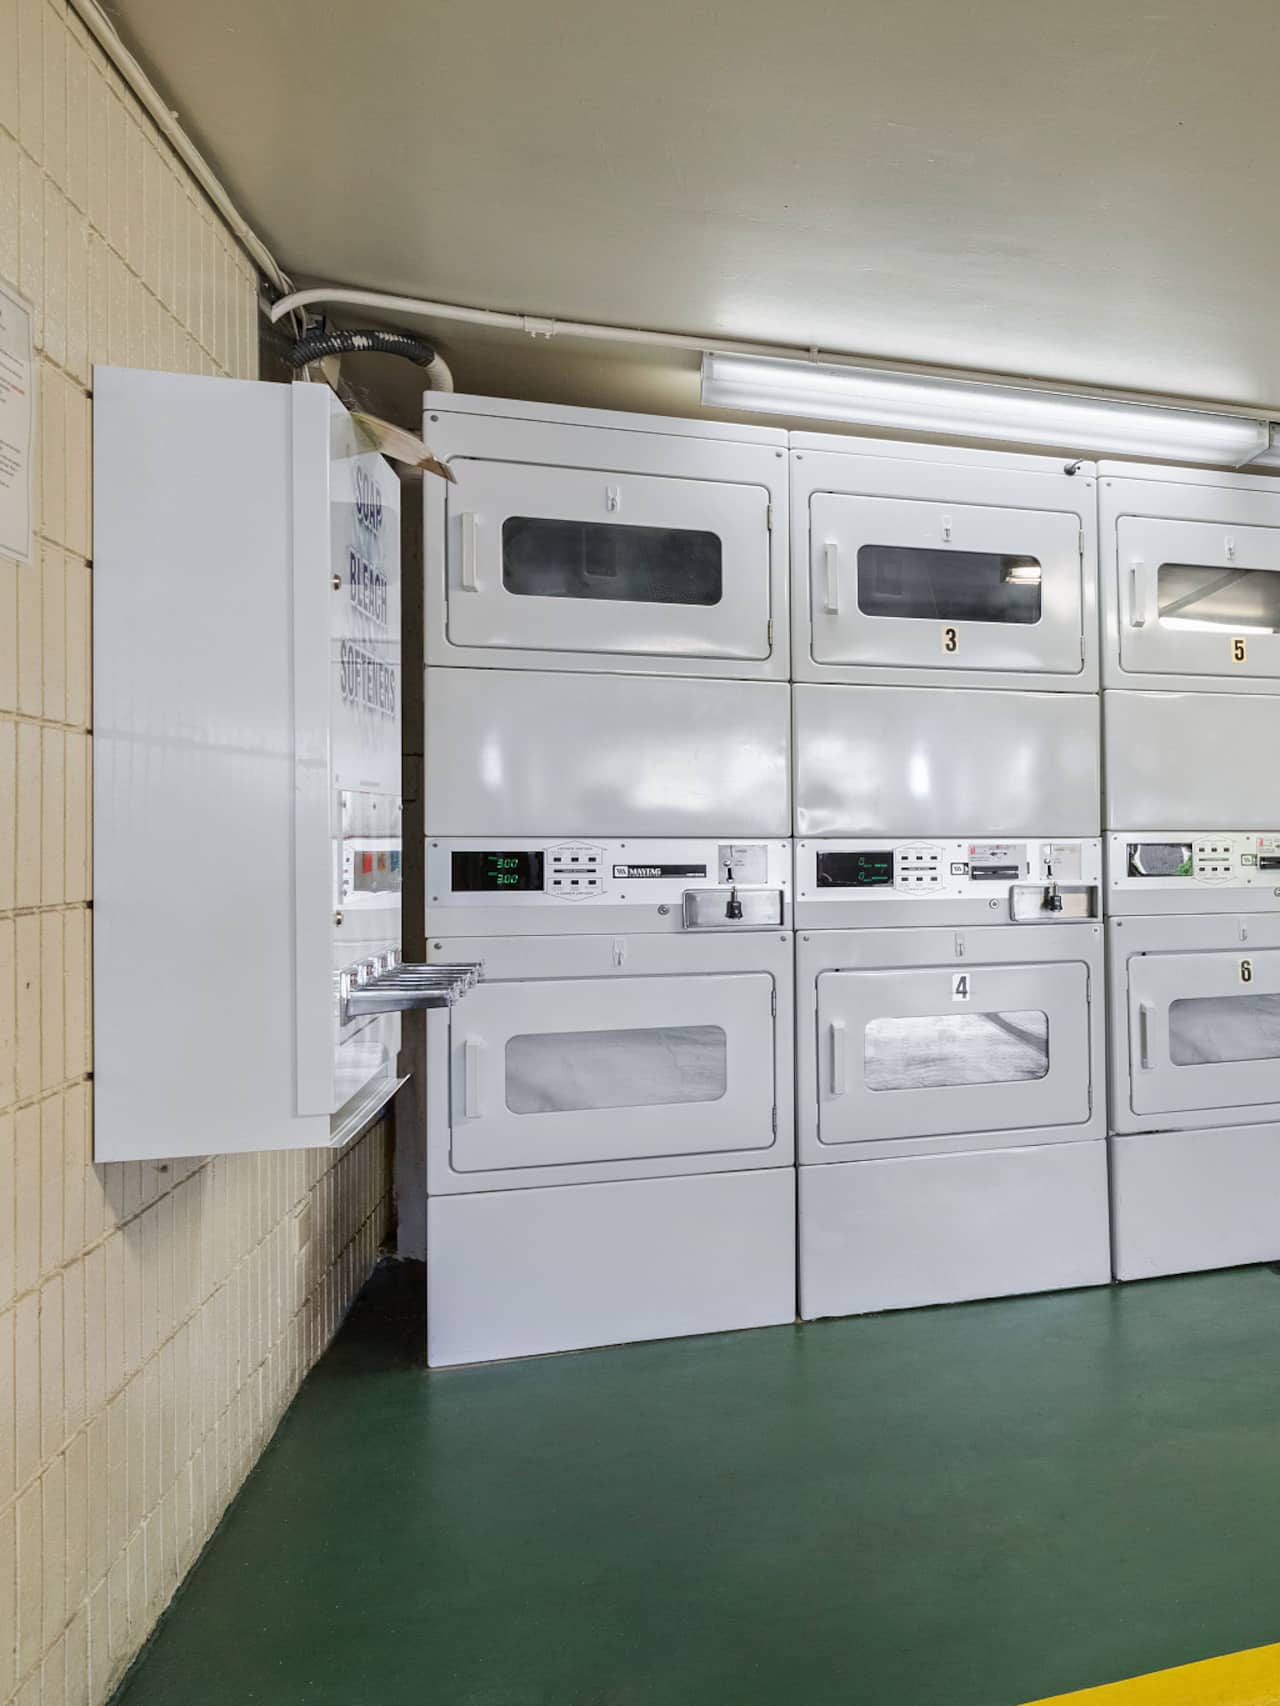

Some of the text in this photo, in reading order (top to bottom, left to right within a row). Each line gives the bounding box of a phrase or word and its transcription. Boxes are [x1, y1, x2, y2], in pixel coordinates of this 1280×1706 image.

[357, 465, 382, 528] SOAP
[350, 551, 387, 625] BLEACH
[945, 628, 957, 652] 3
[1234, 640, 1245, 661] 5
[341, 639, 395, 713] SOFTENERS
[629, 867, 662, 876] MAYTAG
[1240, 960, 1252, 982] 6
[955, 976, 968, 998] 4
